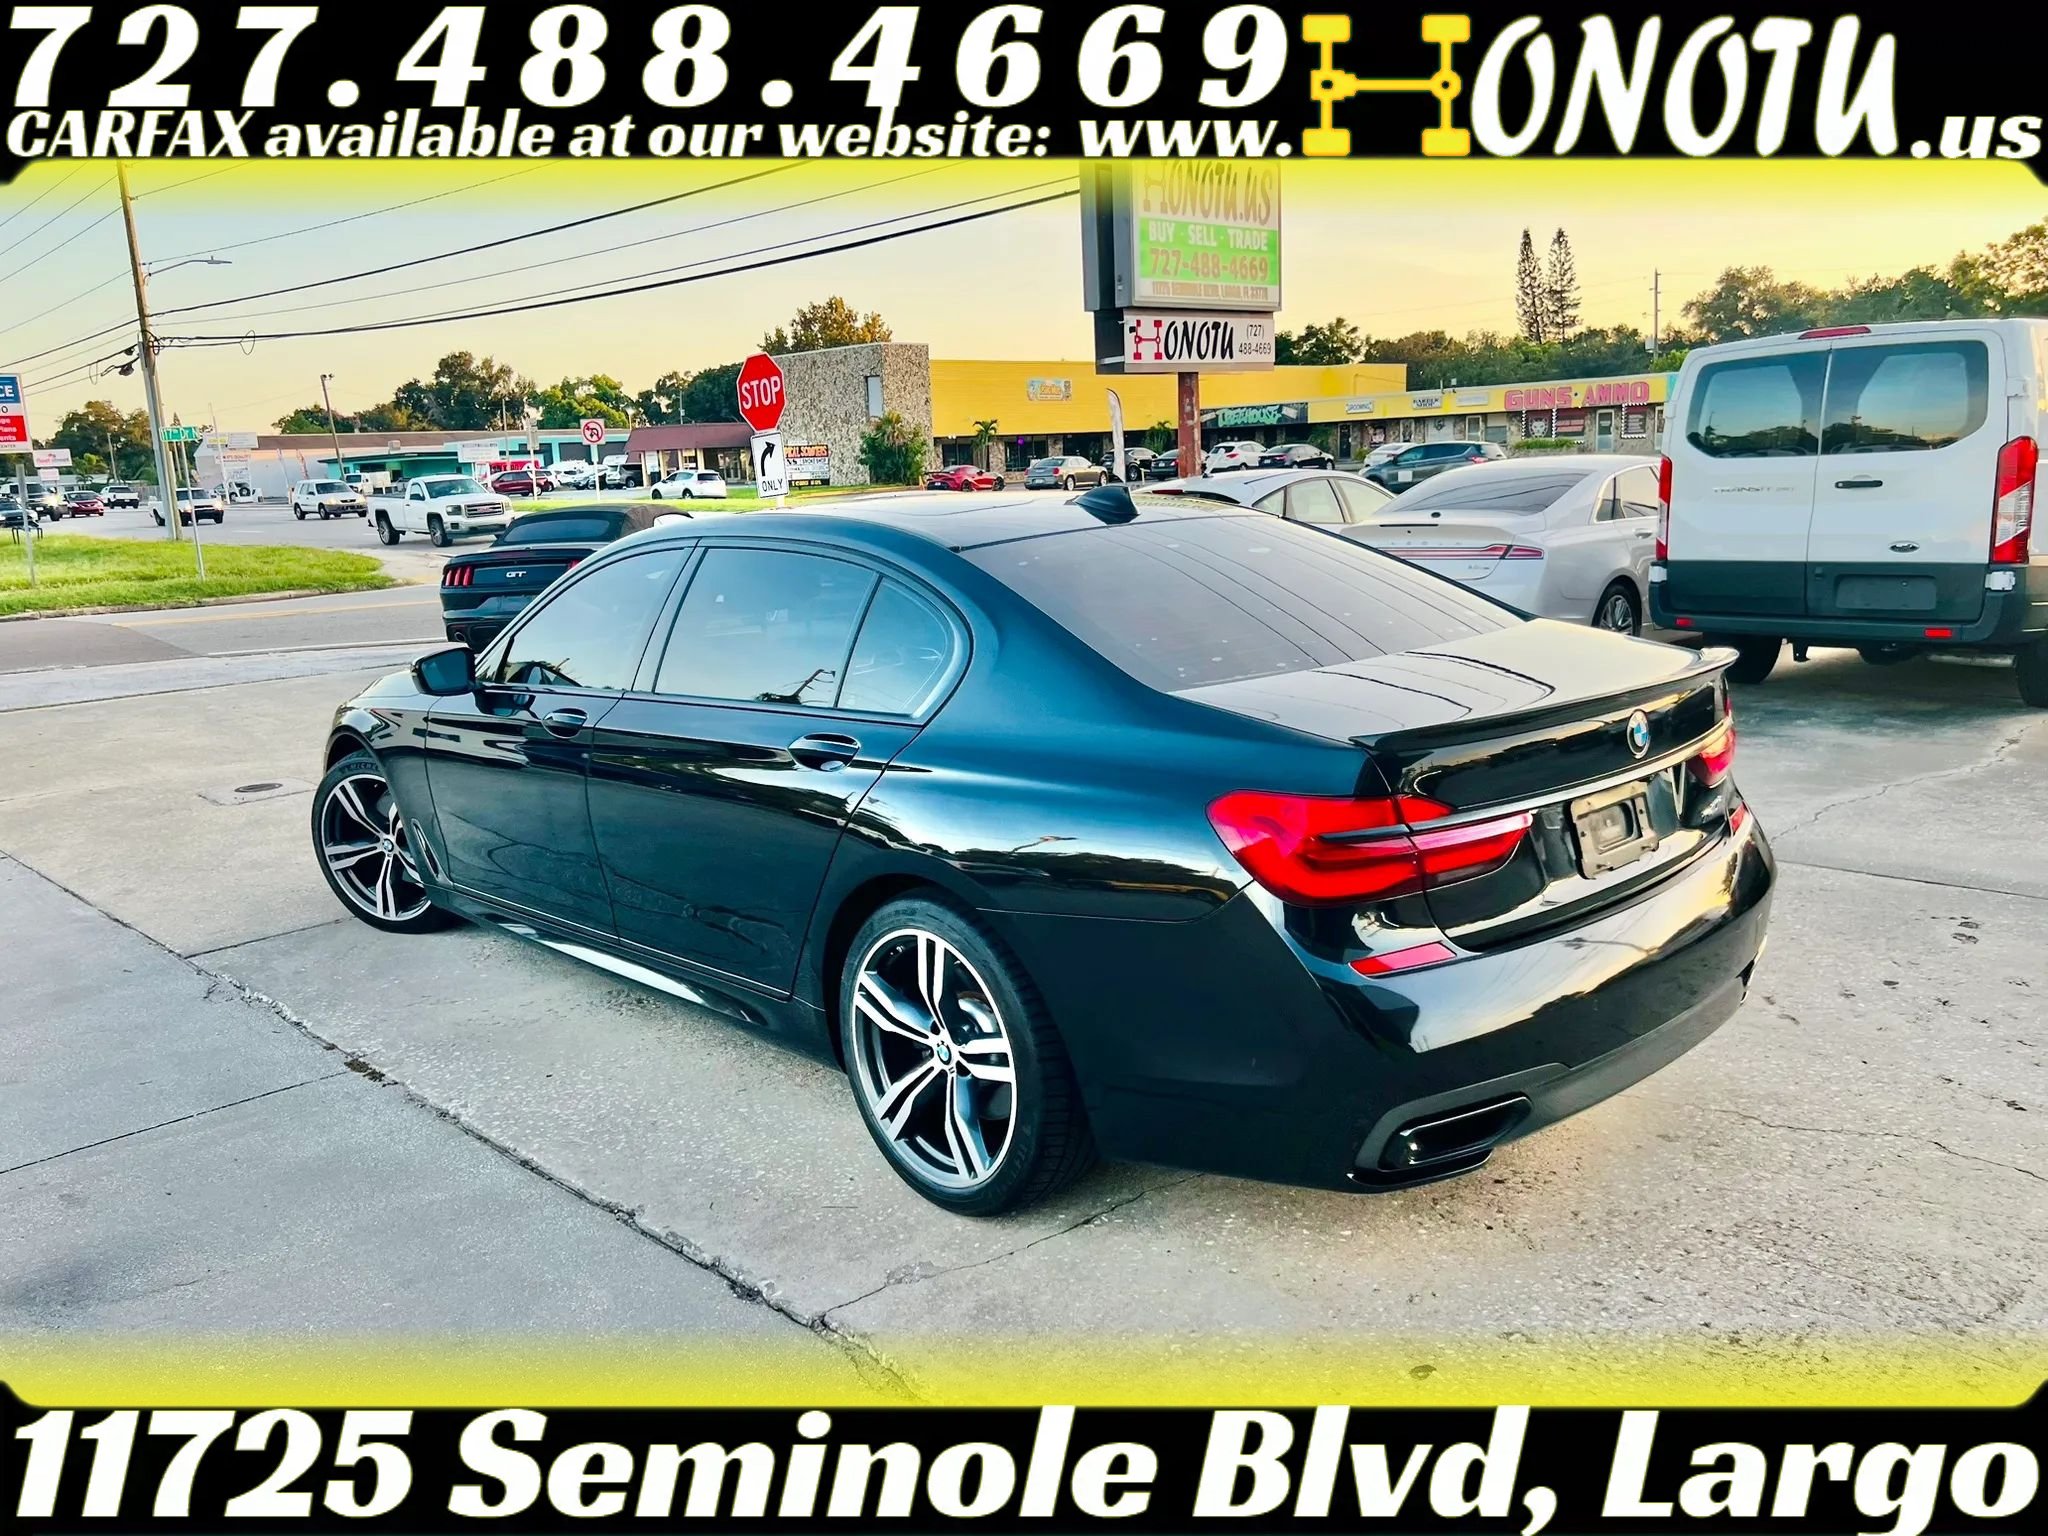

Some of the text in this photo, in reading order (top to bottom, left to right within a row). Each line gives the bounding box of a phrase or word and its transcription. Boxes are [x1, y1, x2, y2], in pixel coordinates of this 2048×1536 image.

[1149, 219, 1268, 251] BUY SELL TRADE
[1150, 247, 1268, 282] 727-488-4669
[1133, 319, 1234, 361] HONOTU
[1246, 324, 1265, 340] (727)
[1238, 342, 1272, 355] 488-4669
[741, 375, 781, 410] STOP
[1504, 381, 1650, 411] GUNS AMMO
[761, 478, 784, 493] ONLY
[505, 570, 527, 578] GT
